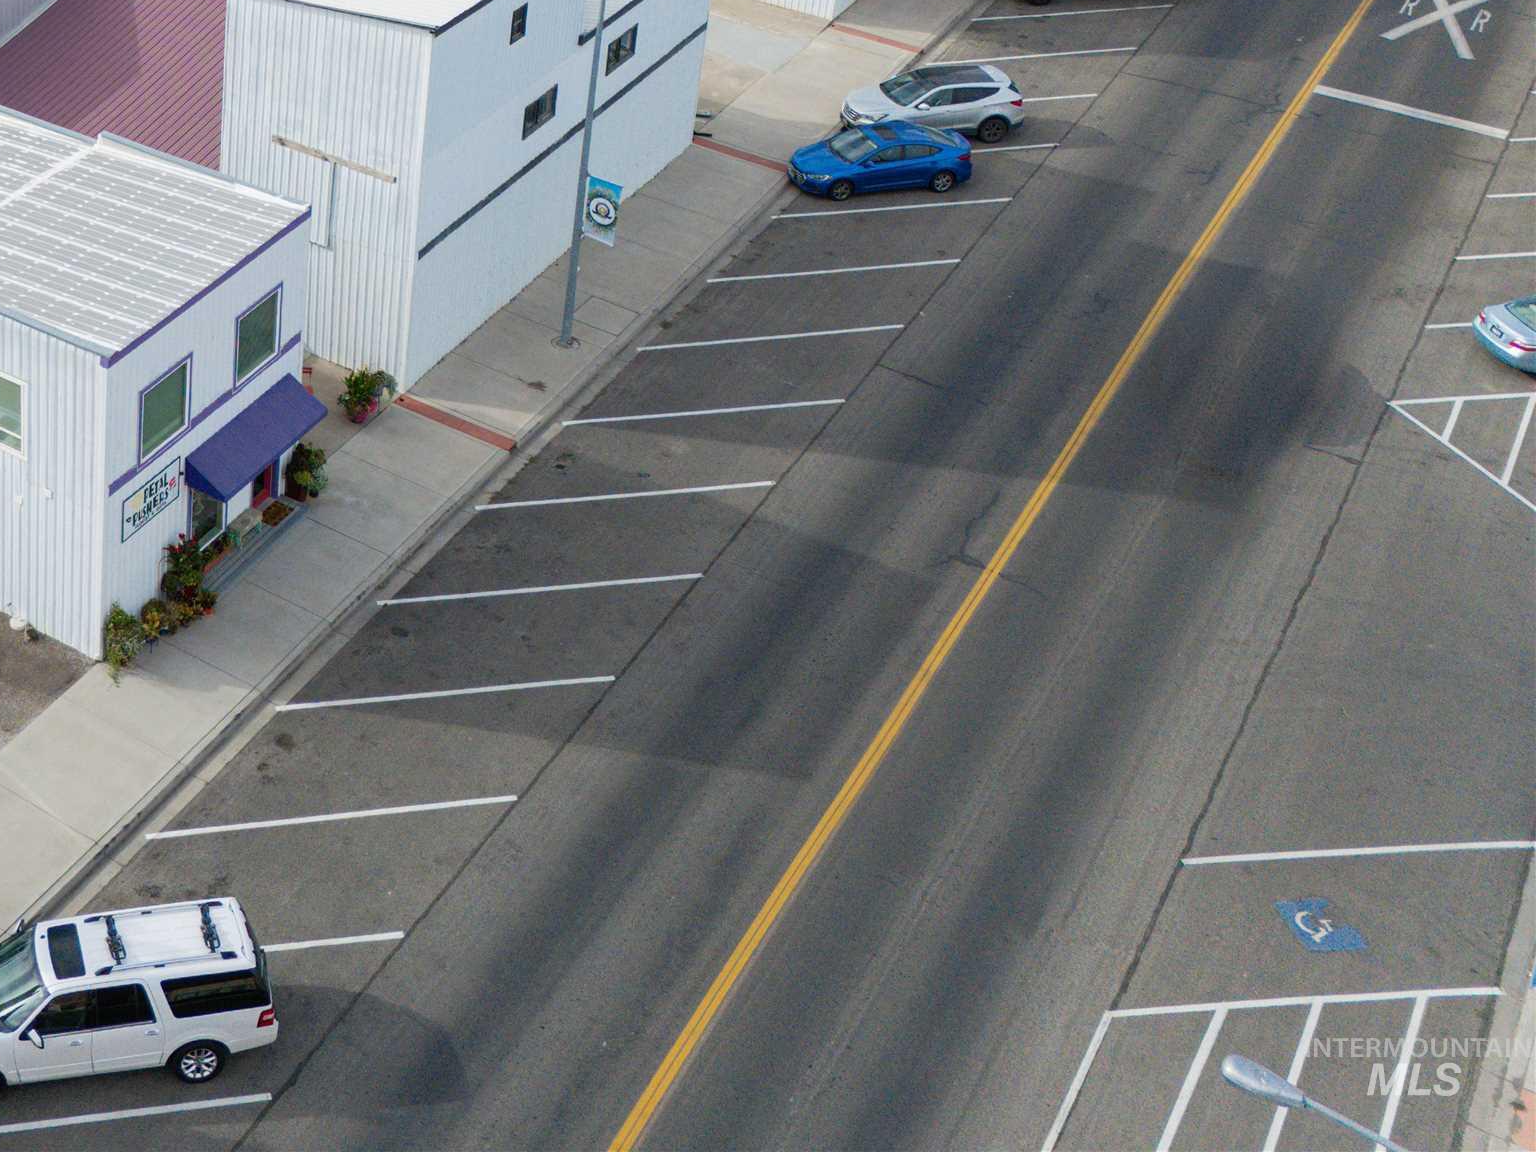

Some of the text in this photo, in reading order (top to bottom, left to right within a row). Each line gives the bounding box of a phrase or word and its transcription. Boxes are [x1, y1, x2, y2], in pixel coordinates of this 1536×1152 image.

[1470, 9, 1492, 32] R
[144, 472, 168, 503] PETAL
[132, 487, 168, 527] PUSHERS
